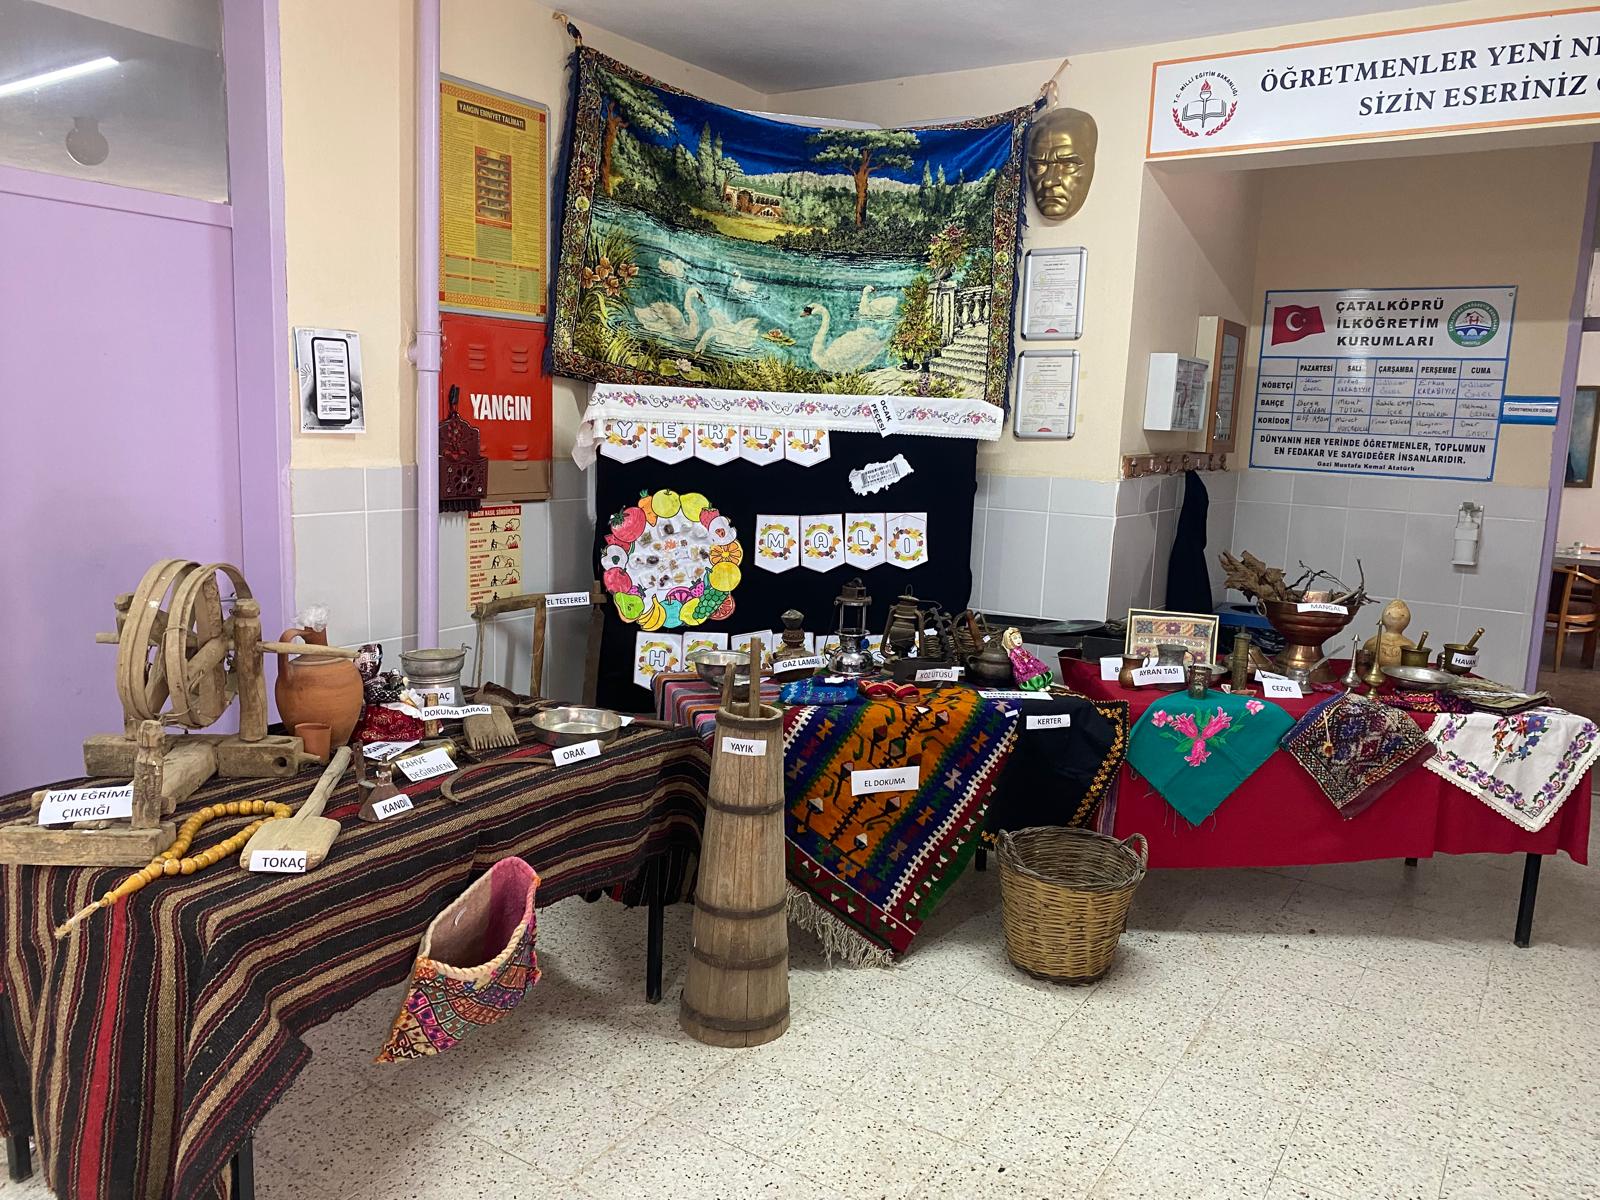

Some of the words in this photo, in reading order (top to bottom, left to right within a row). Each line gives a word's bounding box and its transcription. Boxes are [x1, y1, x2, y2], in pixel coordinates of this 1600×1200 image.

[1261, 49, 1478, 92] ÖĞRETMENLER
[1488, 34, 1562, 66] YENİ
[1359, 87, 1437, 116] SİZİN
[1443, 71, 1588, 108] ESERİNİZ
[1335, 297, 1444, 313] ÇATALKÖPRÜ
[1335, 315, 1439, 329] İLKÖĞRETİM
[1336, 336, 1434, 347] KURUMLARI
[1299, 364, 1333, 372] PAZARTESİ
[1378, 366, 1414, 375] ÇARŞAMBA
[1421, 366, 1457, 375] PERŞEMBE
[1261, 381, 1293, 390] NÖBETÇİ
[470, 393, 532, 421] YANGIN
[1260, 399, 1285, 408] BAHÇE
[880, 399, 892, 422] OCAK
[1257, 415, 1290, 425] KORİDOR
[1260, 434, 1302, 446] DÜNYANIN
[1304, 438, 1321, 446] HER
[1323, 437, 1360, 448] YERİNDE
[1363, 438, 1432, 452] ÖĞRETMENLER,
[1434, 442, 1487, 454] TOPLUMUN
[1274, 446, 1286, 456] EN
[1287, 447, 1326, 458] FEDAKAR
[1327, 450, 1339, 458] VE
[1340, 450, 1395, 462] SAYGIDEĞER
[1398, 452, 1467, 464] İNSANLARIDIR.
[556, 595, 588, 605] TESTERESİ
[1310, 603, 1341, 612] MANGAL
[782, 660, 797, 668] GAZ
[1454, 657, 1477, 666] HAVAN
[1139, 669, 1162, 677] AYRAN
[1271, 685, 1293, 693] CEZVE
[424, 708, 460, 718] DOKUMA
[1037, 717, 1062, 726] KERTER
[561, 747, 587, 760] ORAK
[730, 741, 755, 754] YAYIK
[399, 755, 428, 770] KAHVE
[864, 779, 873, 788] EL
[873, 778, 906, 787] DOKUMA
[49, 791, 79, 803] YÜN
[80, 788, 132, 801] EĞRİME
[61, 804, 110, 820] ÇIKRIĞI
[262, 857, 306, 871] TOKAÇ
